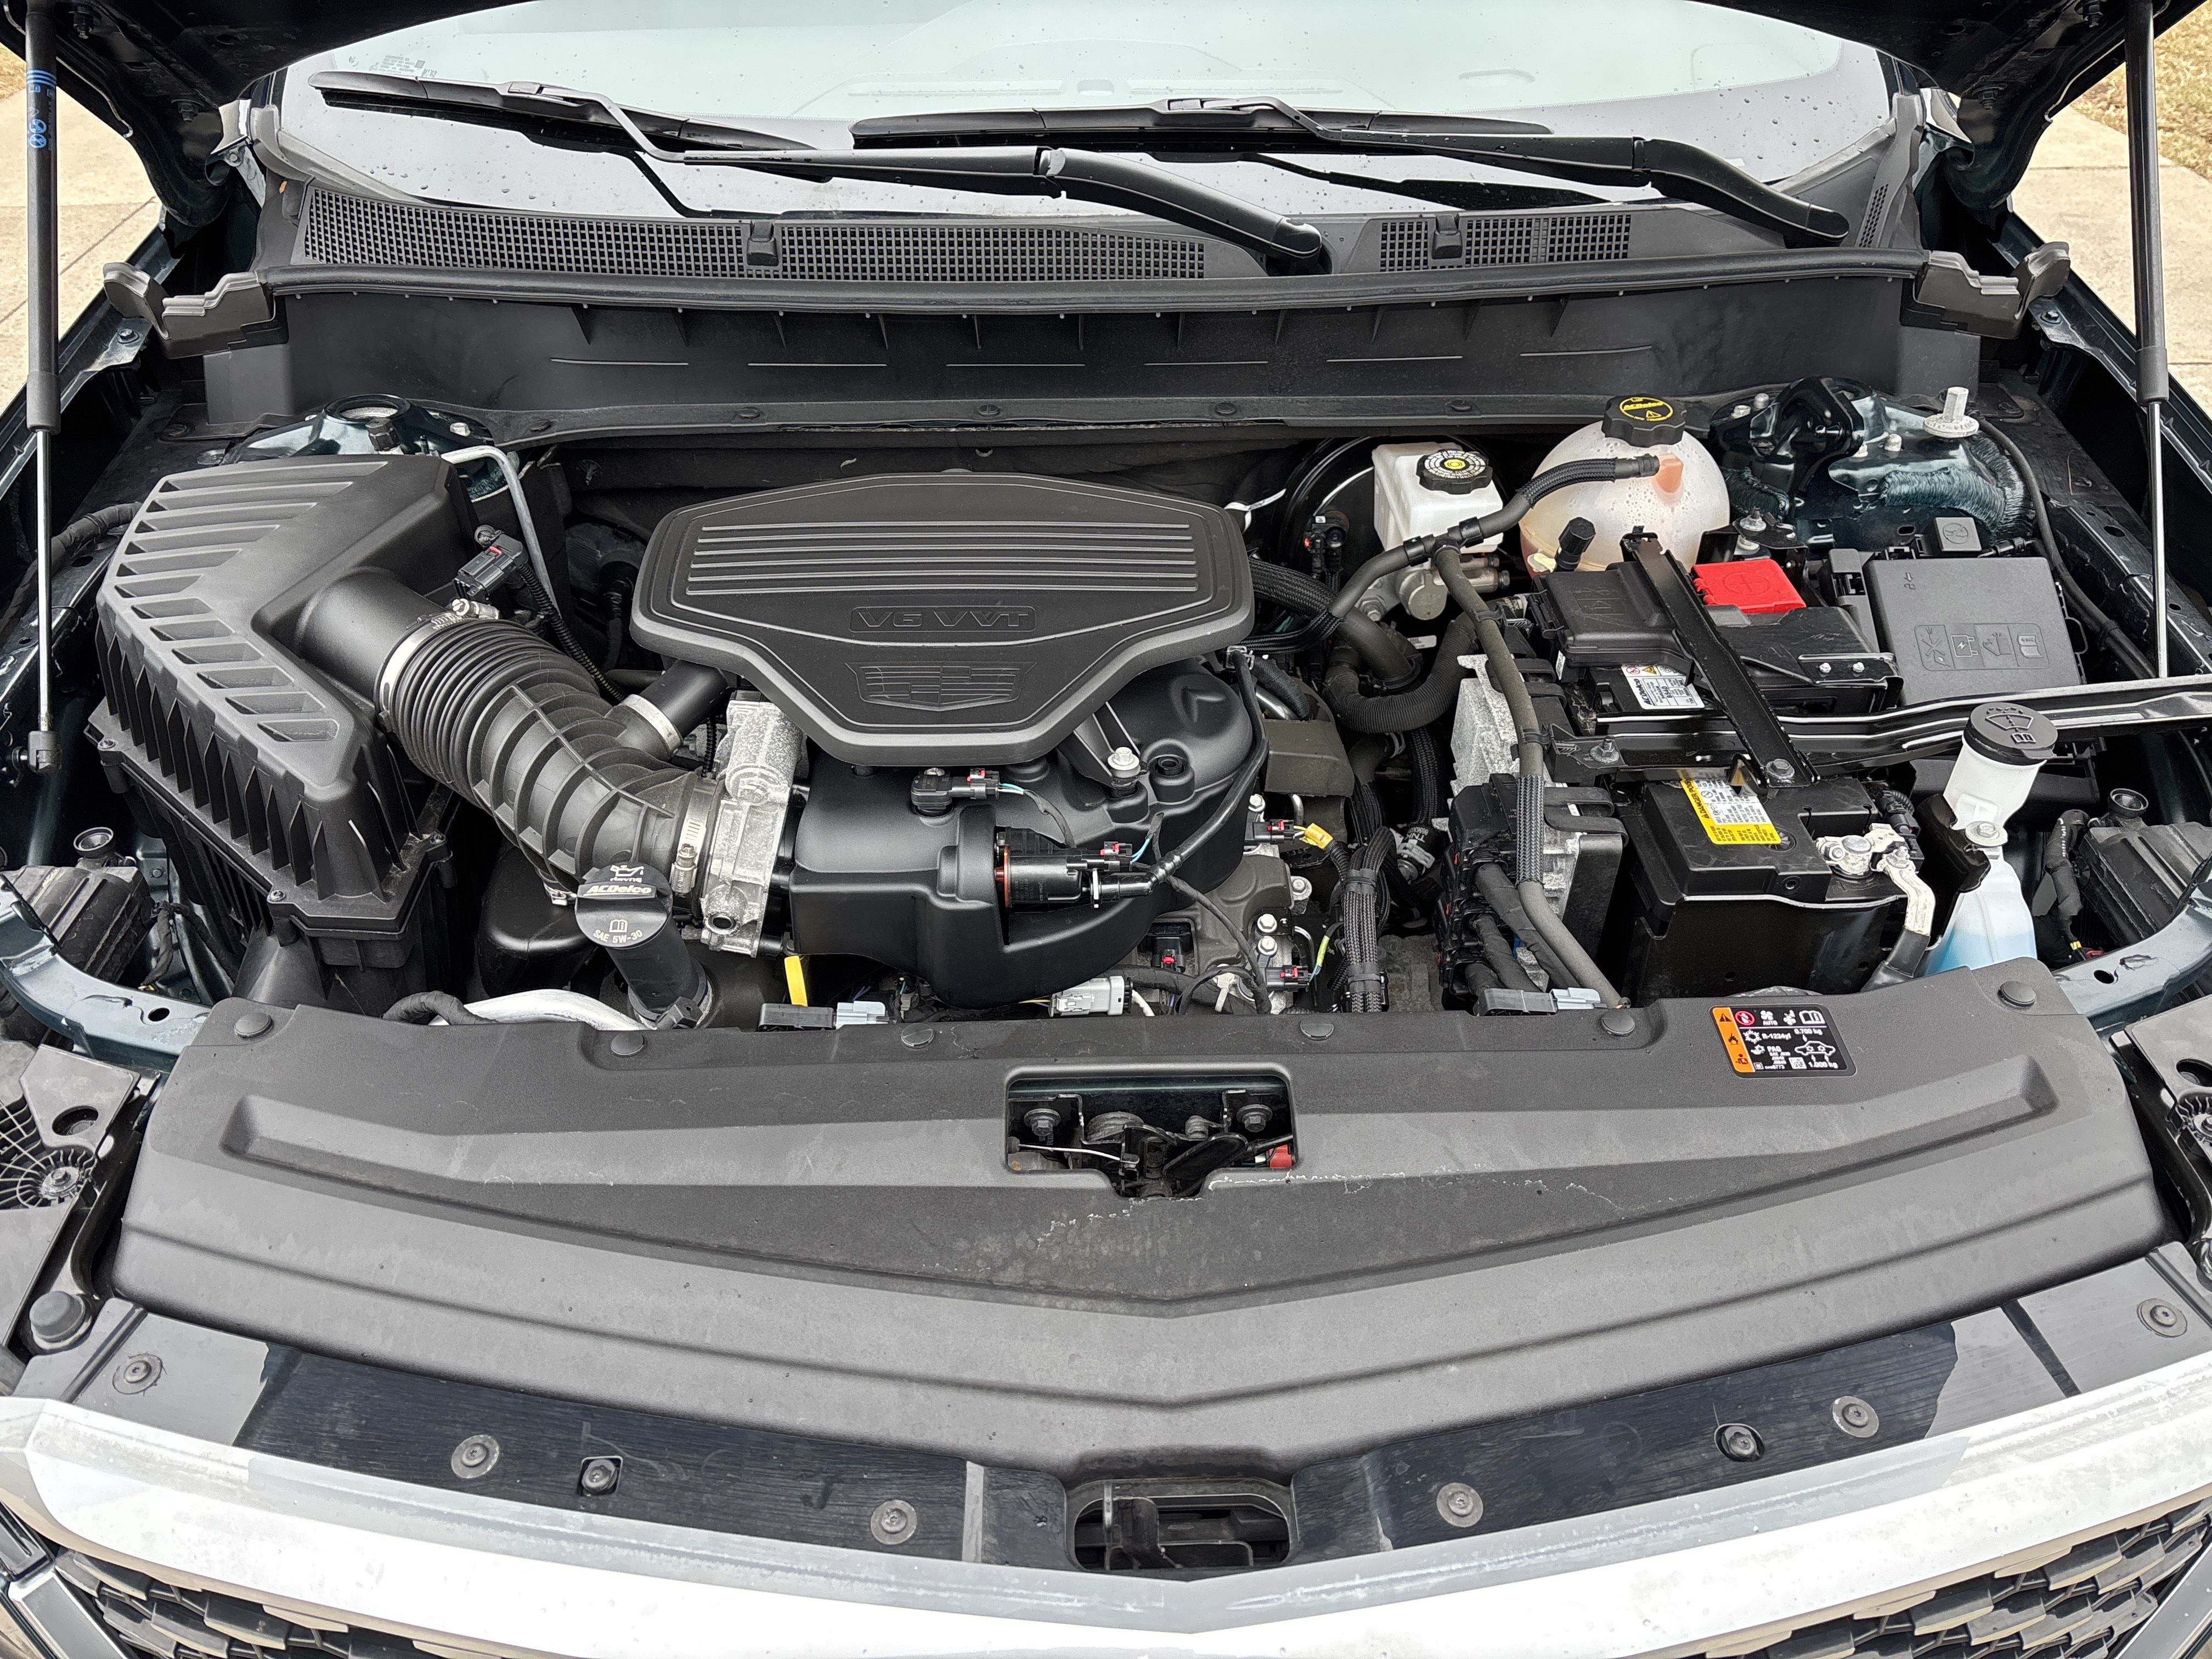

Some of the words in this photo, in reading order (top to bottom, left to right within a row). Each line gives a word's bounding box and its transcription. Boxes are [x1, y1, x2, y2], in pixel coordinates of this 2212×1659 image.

[858, 611, 923, 627] V6
[933, 611, 1029, 627] VVT
[1633, 678, 1652, 706] ACDelco
[586, 885, 652, 894] ACDelco
[593, 929, 610, 943] SAE
[612, 929, 643, 944] 5W-30
